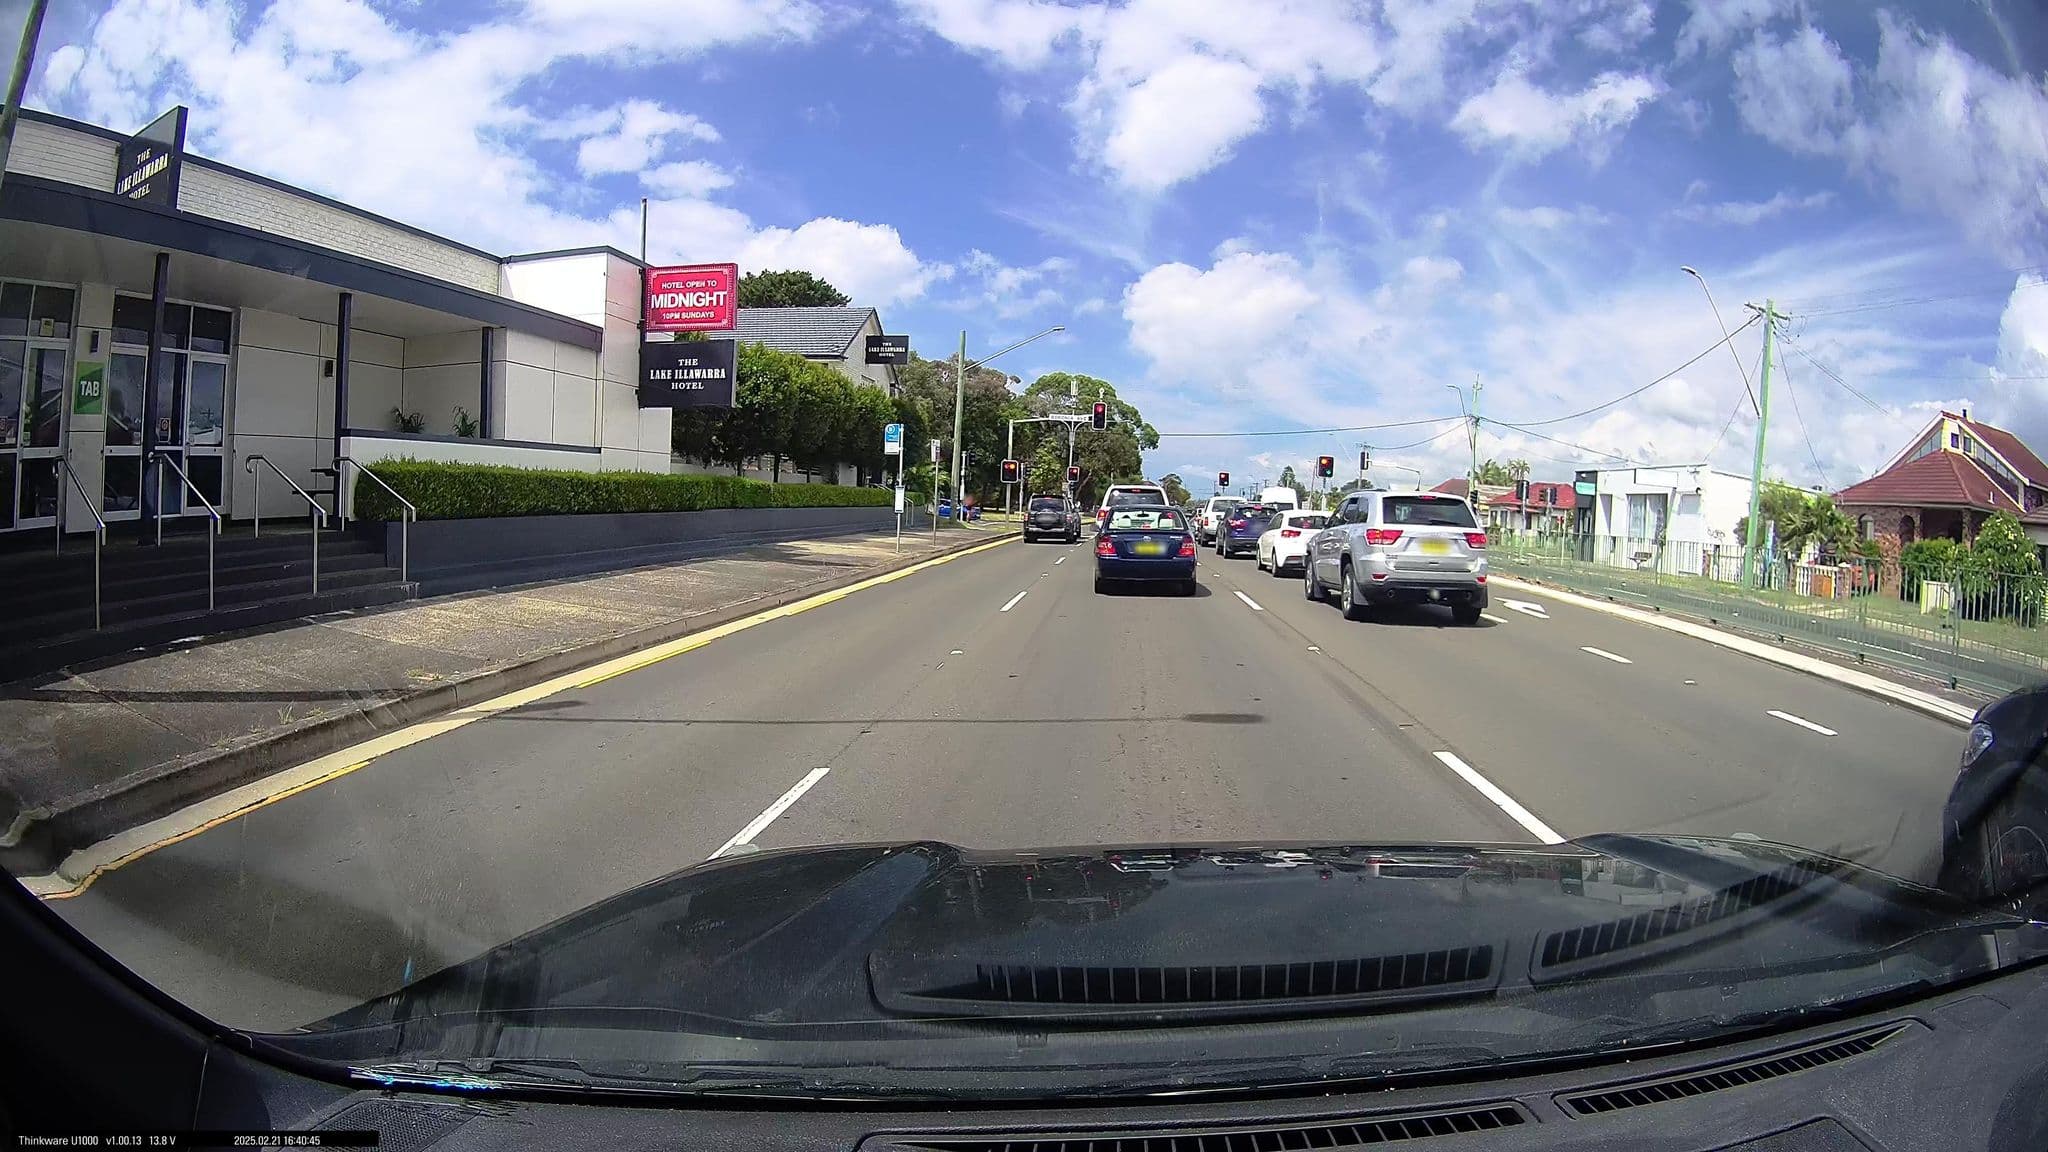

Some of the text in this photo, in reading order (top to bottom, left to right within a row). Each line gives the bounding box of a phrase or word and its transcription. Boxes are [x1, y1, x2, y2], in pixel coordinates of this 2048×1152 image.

[137, 148, 151, 164] THE
[651, 291, 727, 309] MIDNIGHT
[663, 311, 714, 320] 10PM SUNDAYS
[650, 368, 726, 379] LAKE ILLAWARRA
[80, 380, 100, 397] TAB
[671, 382, 704, 390] HOTEL
